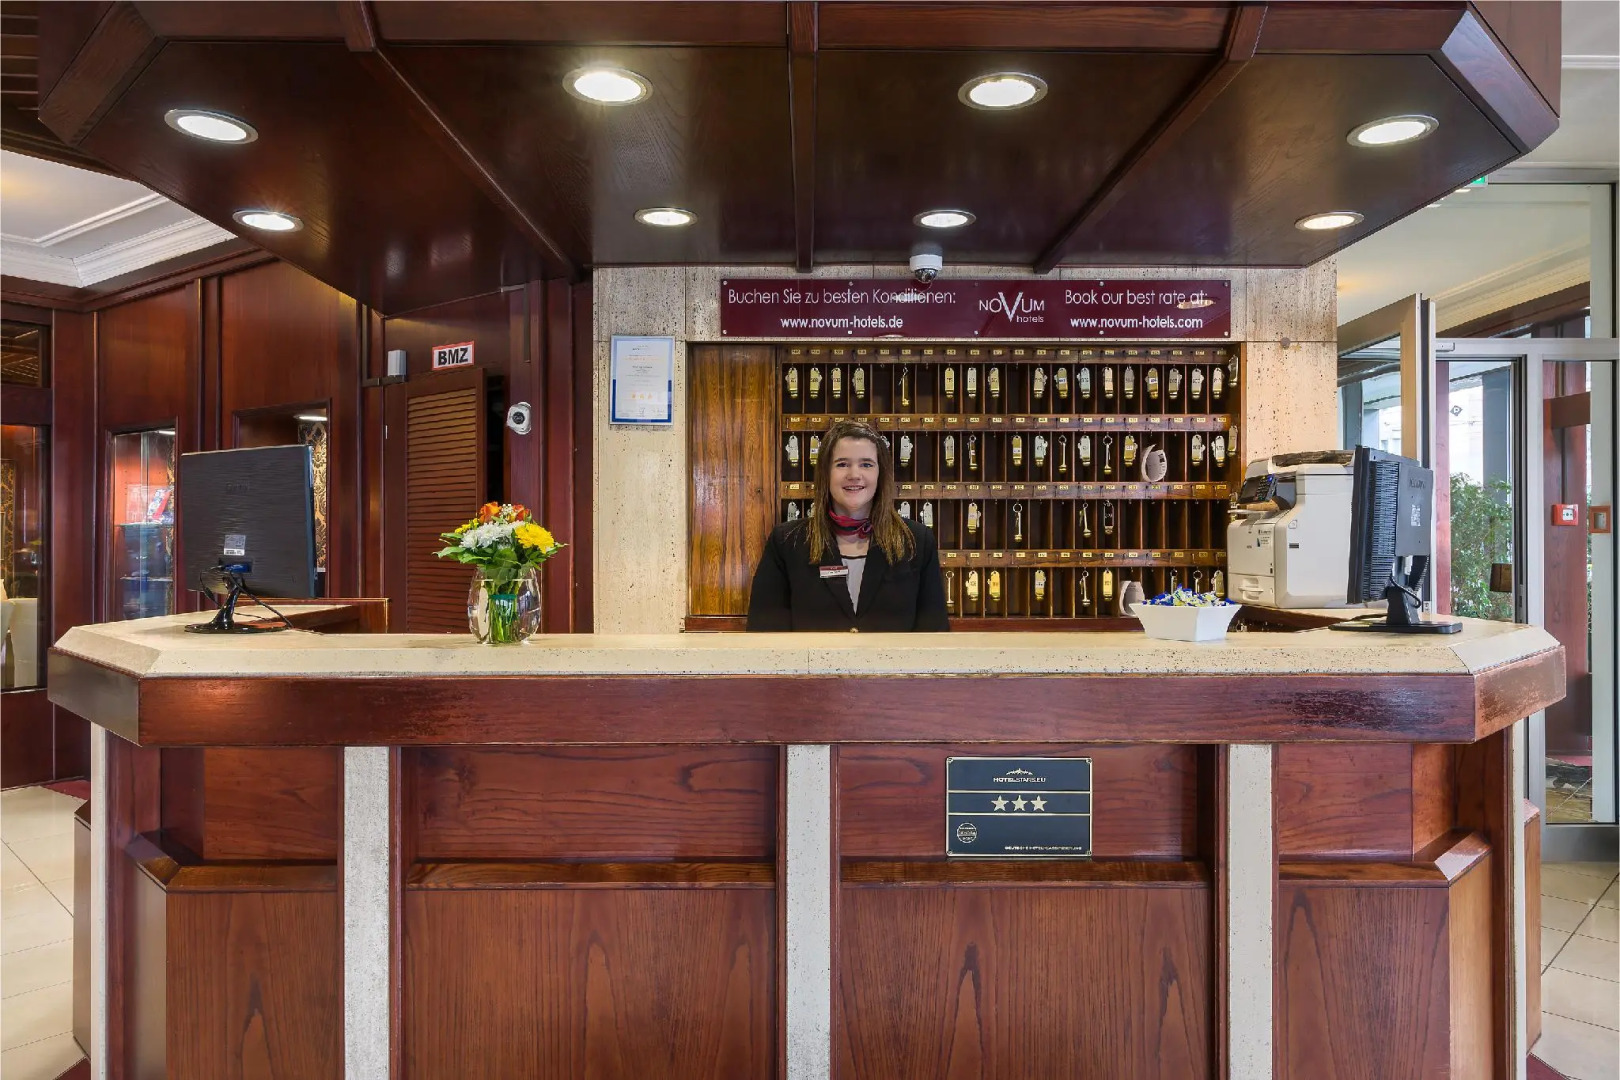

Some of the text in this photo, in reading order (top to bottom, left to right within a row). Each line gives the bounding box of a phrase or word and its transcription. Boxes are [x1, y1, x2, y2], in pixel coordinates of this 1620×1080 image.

[728, 288, 780, 304] Buchen
[783, 288, 801, 304] Sie
[804, 291, 820, 304] zu
[823, 288, 869, 304] besten
[1065, 289, 1099, 305] Book
[1101, 292, 1124, 305] our
[1126, 289, 1156, 305] best
[1158, 289, 1186, 305] rate
[979, 291, 1045, 322] NOVUM
[780, 315, 904, 329] www.novum-hotels.de
[1016, 315, 1045, 323] hotels
[1070, 315, 1203, 329] www.novum-hotels.com
[438, 347, 468, 366] BMZ
